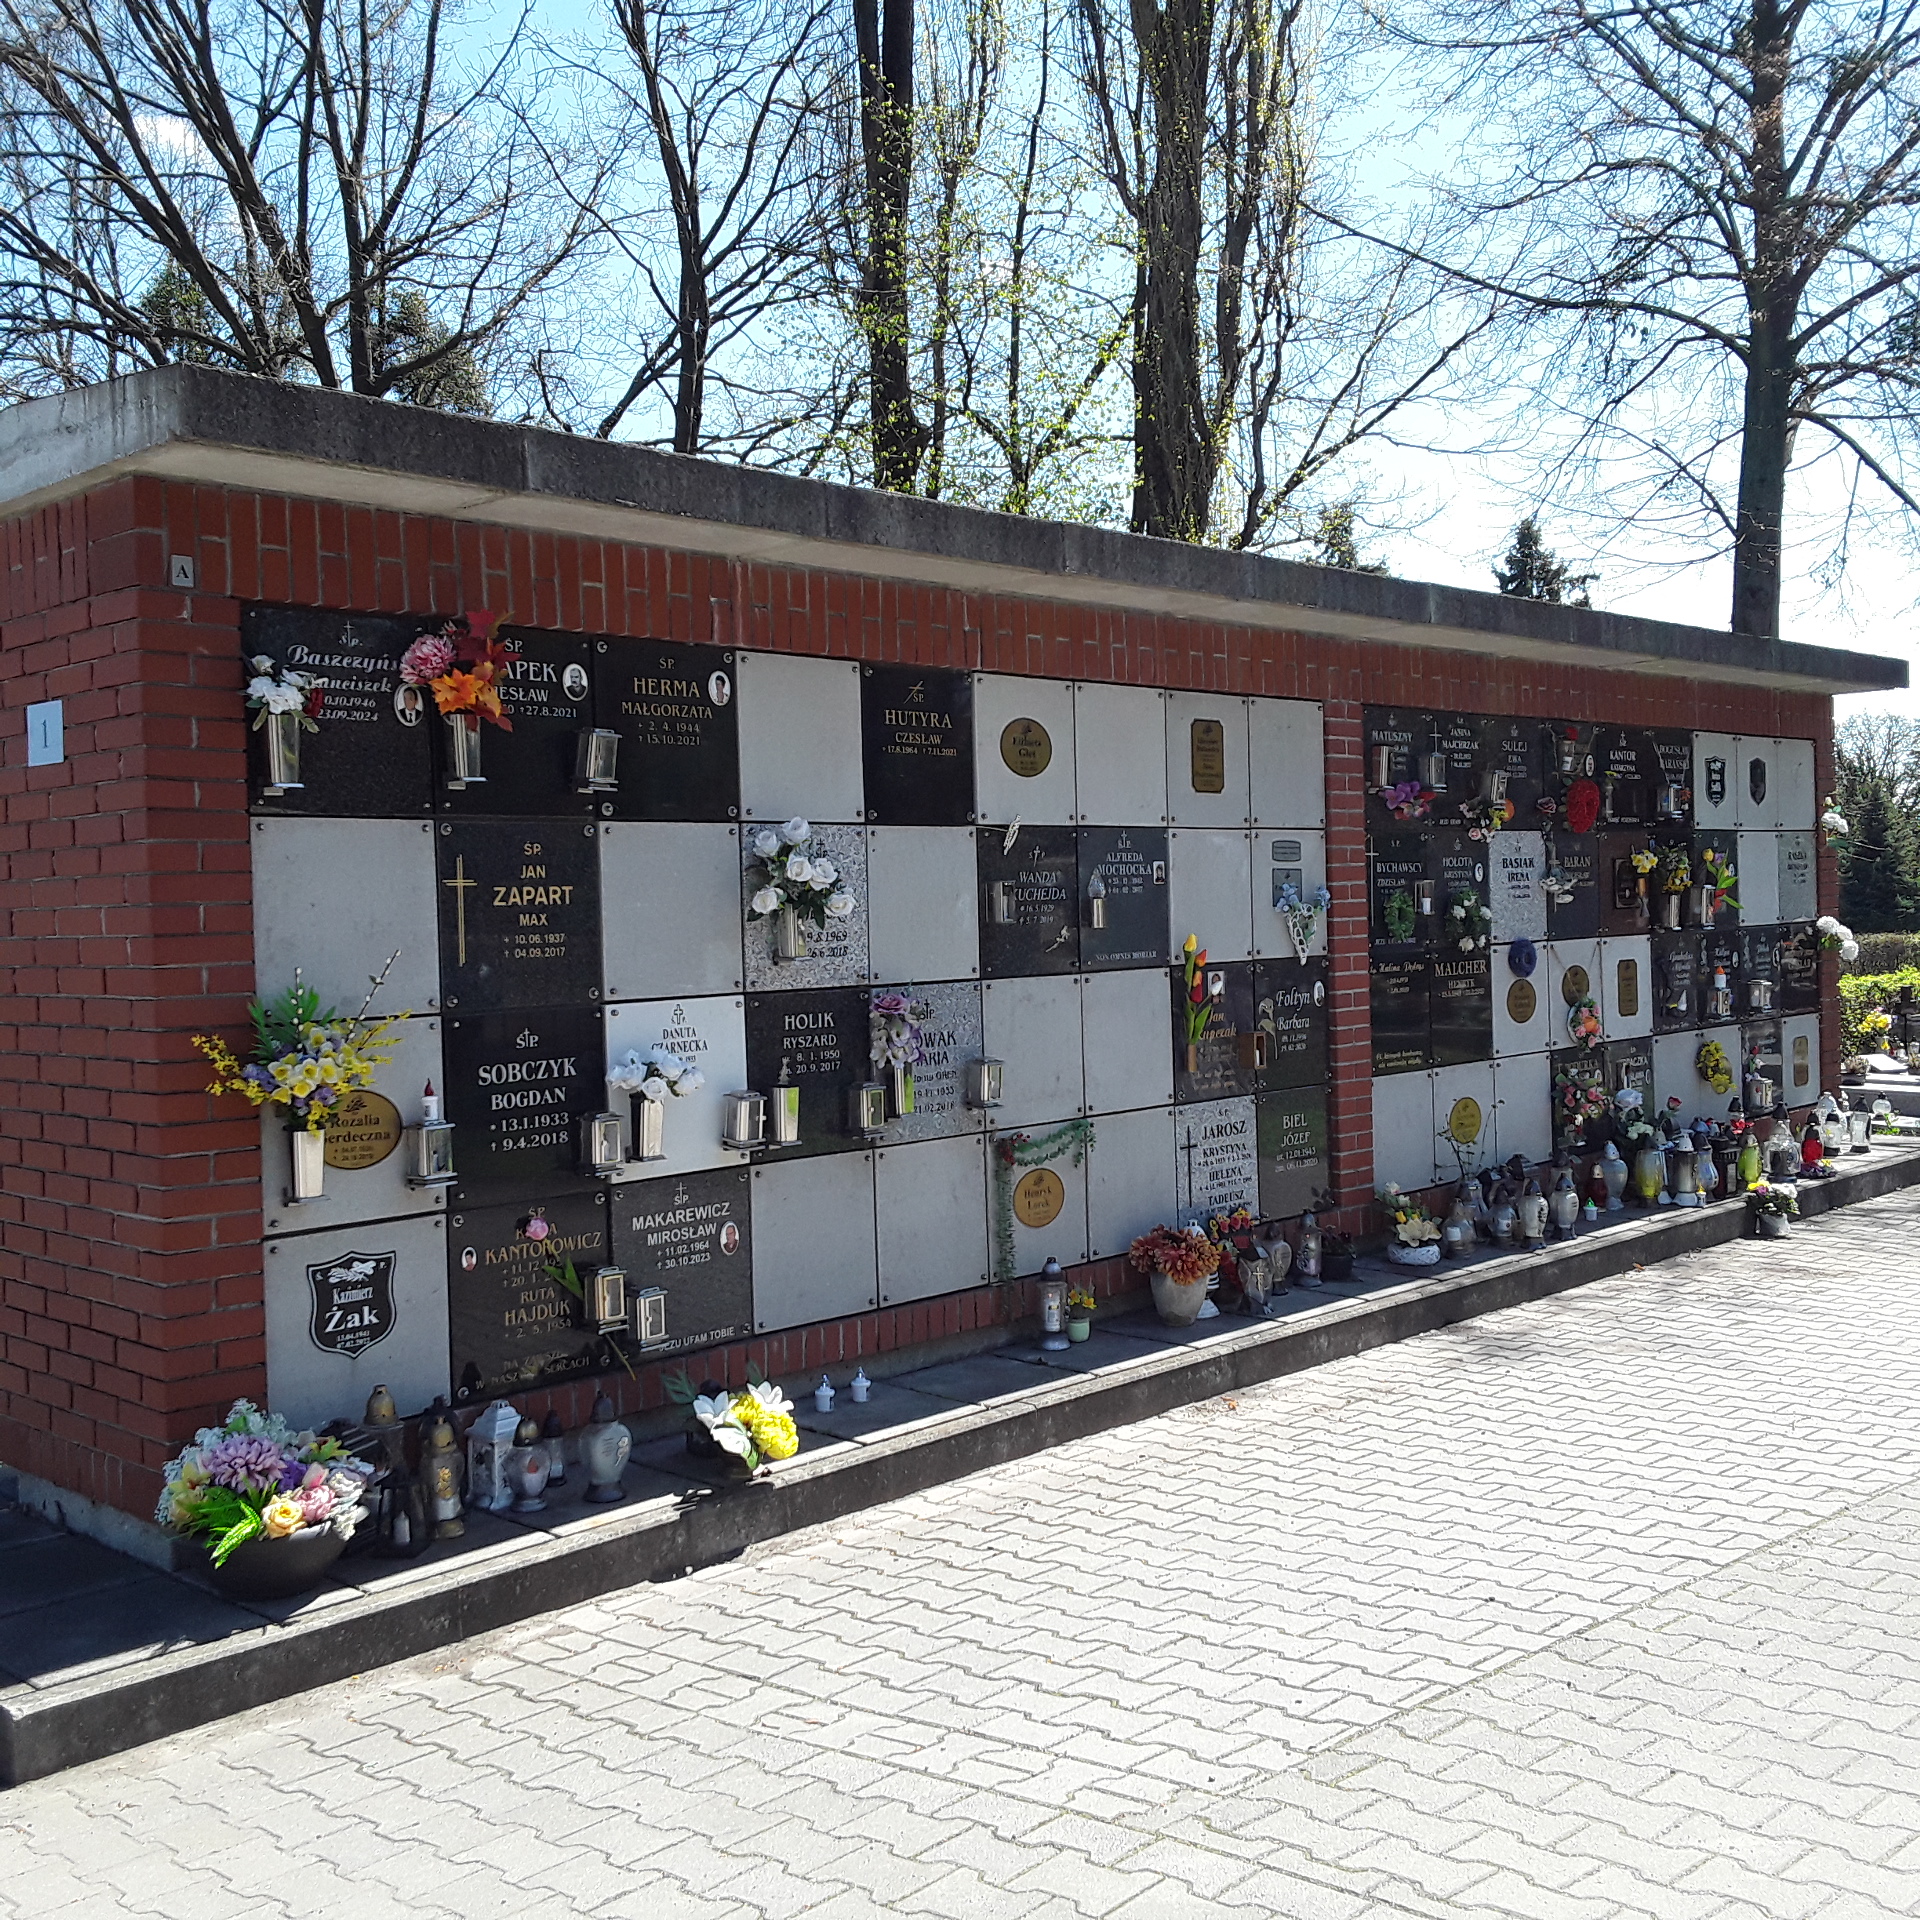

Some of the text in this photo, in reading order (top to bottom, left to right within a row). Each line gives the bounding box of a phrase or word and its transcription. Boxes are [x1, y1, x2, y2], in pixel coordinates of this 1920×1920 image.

[176, 565, 189, 579] A
[287, 645, 401, 673] Baszczyńs
[495, 686, 549, 702] IESŁAW
[633, 677, 701, 698] HERMA
[324, 695, 376, 708] 0.10.1946
[621, 702, 713, 719] MAŁGORZATA
[884, 709, 953, 729] HUTYRA
[42, 719, 49, 748] 1
[895, 732, 943, 744] CZESŁAW
[1501, 740, 1528, 752] SULEJ
[1609, 750, 1637, 761] KANTOR
[1106, 852, 1144, 862] ALFREDA
[1502, 857, 1535, 869] BASIAK
[520, 865, 546, 879] JAN
[1377, 862, 1422, 873] BYCHAWSCY
[1019, 871, 1057, 884] WANDA
[1507, 872, 1530, 882] IRENA
[493, 885, 574, 906] ZAPART
[519, 914, 548, 926] MAX
[515, 934, 566, 944] 10.06.1937
[515, 947, 566, 958] 04.09.2017
[1435, 960, 1487, 977] MALCHER
[1276, 987, 1310, 1011] Foltyn
[784, 1012, 835, 1030] HOLIK
[1208, 1008, 1226, 1025] Jan
[1277, 1013, 1310, 1031] Barbara
[663, 1026, 697, 1039] DANUTA
[1200, 1022, 1237, 1041] upczak
[783, 1034, 837, 1049] RYSZARD
[478, 1057, 577, 1086] SOBCZYK
[491, 1087, 566, 1110] BOGDAN
[501, 1112, 569, 1131] 13.1.1933
[1283, 1113, 1307, 1129] BIEL
[1202, 1120, 1247, 1140] JAROSZ
[502, 1131, 569, 1151] 9.4.2018
[1281, 1131, 1310, 1147] JÓZEF
[1203, 1142, 1247, 1158] KRYSTYNA
[1209, 1167, 1242, 1182] HELENA
[1208, 1190, 1245, 1206] TADEUSZ
[632, 1202, 731, 1231] MAKAREWICZ
[647, 1223, 717, 1246] MIROSŁAW
[332, 1284, 374, 1305] Kazimierz
[521, 1287, 555, 1303] RUTA
[324, 1305, 380, 1333] Żak
[505, 1300, 571, 1327] HAJDUK
[683, 1332, 708, 1347] UFAM
[710, 1326, 736, 1341] TOBIE
